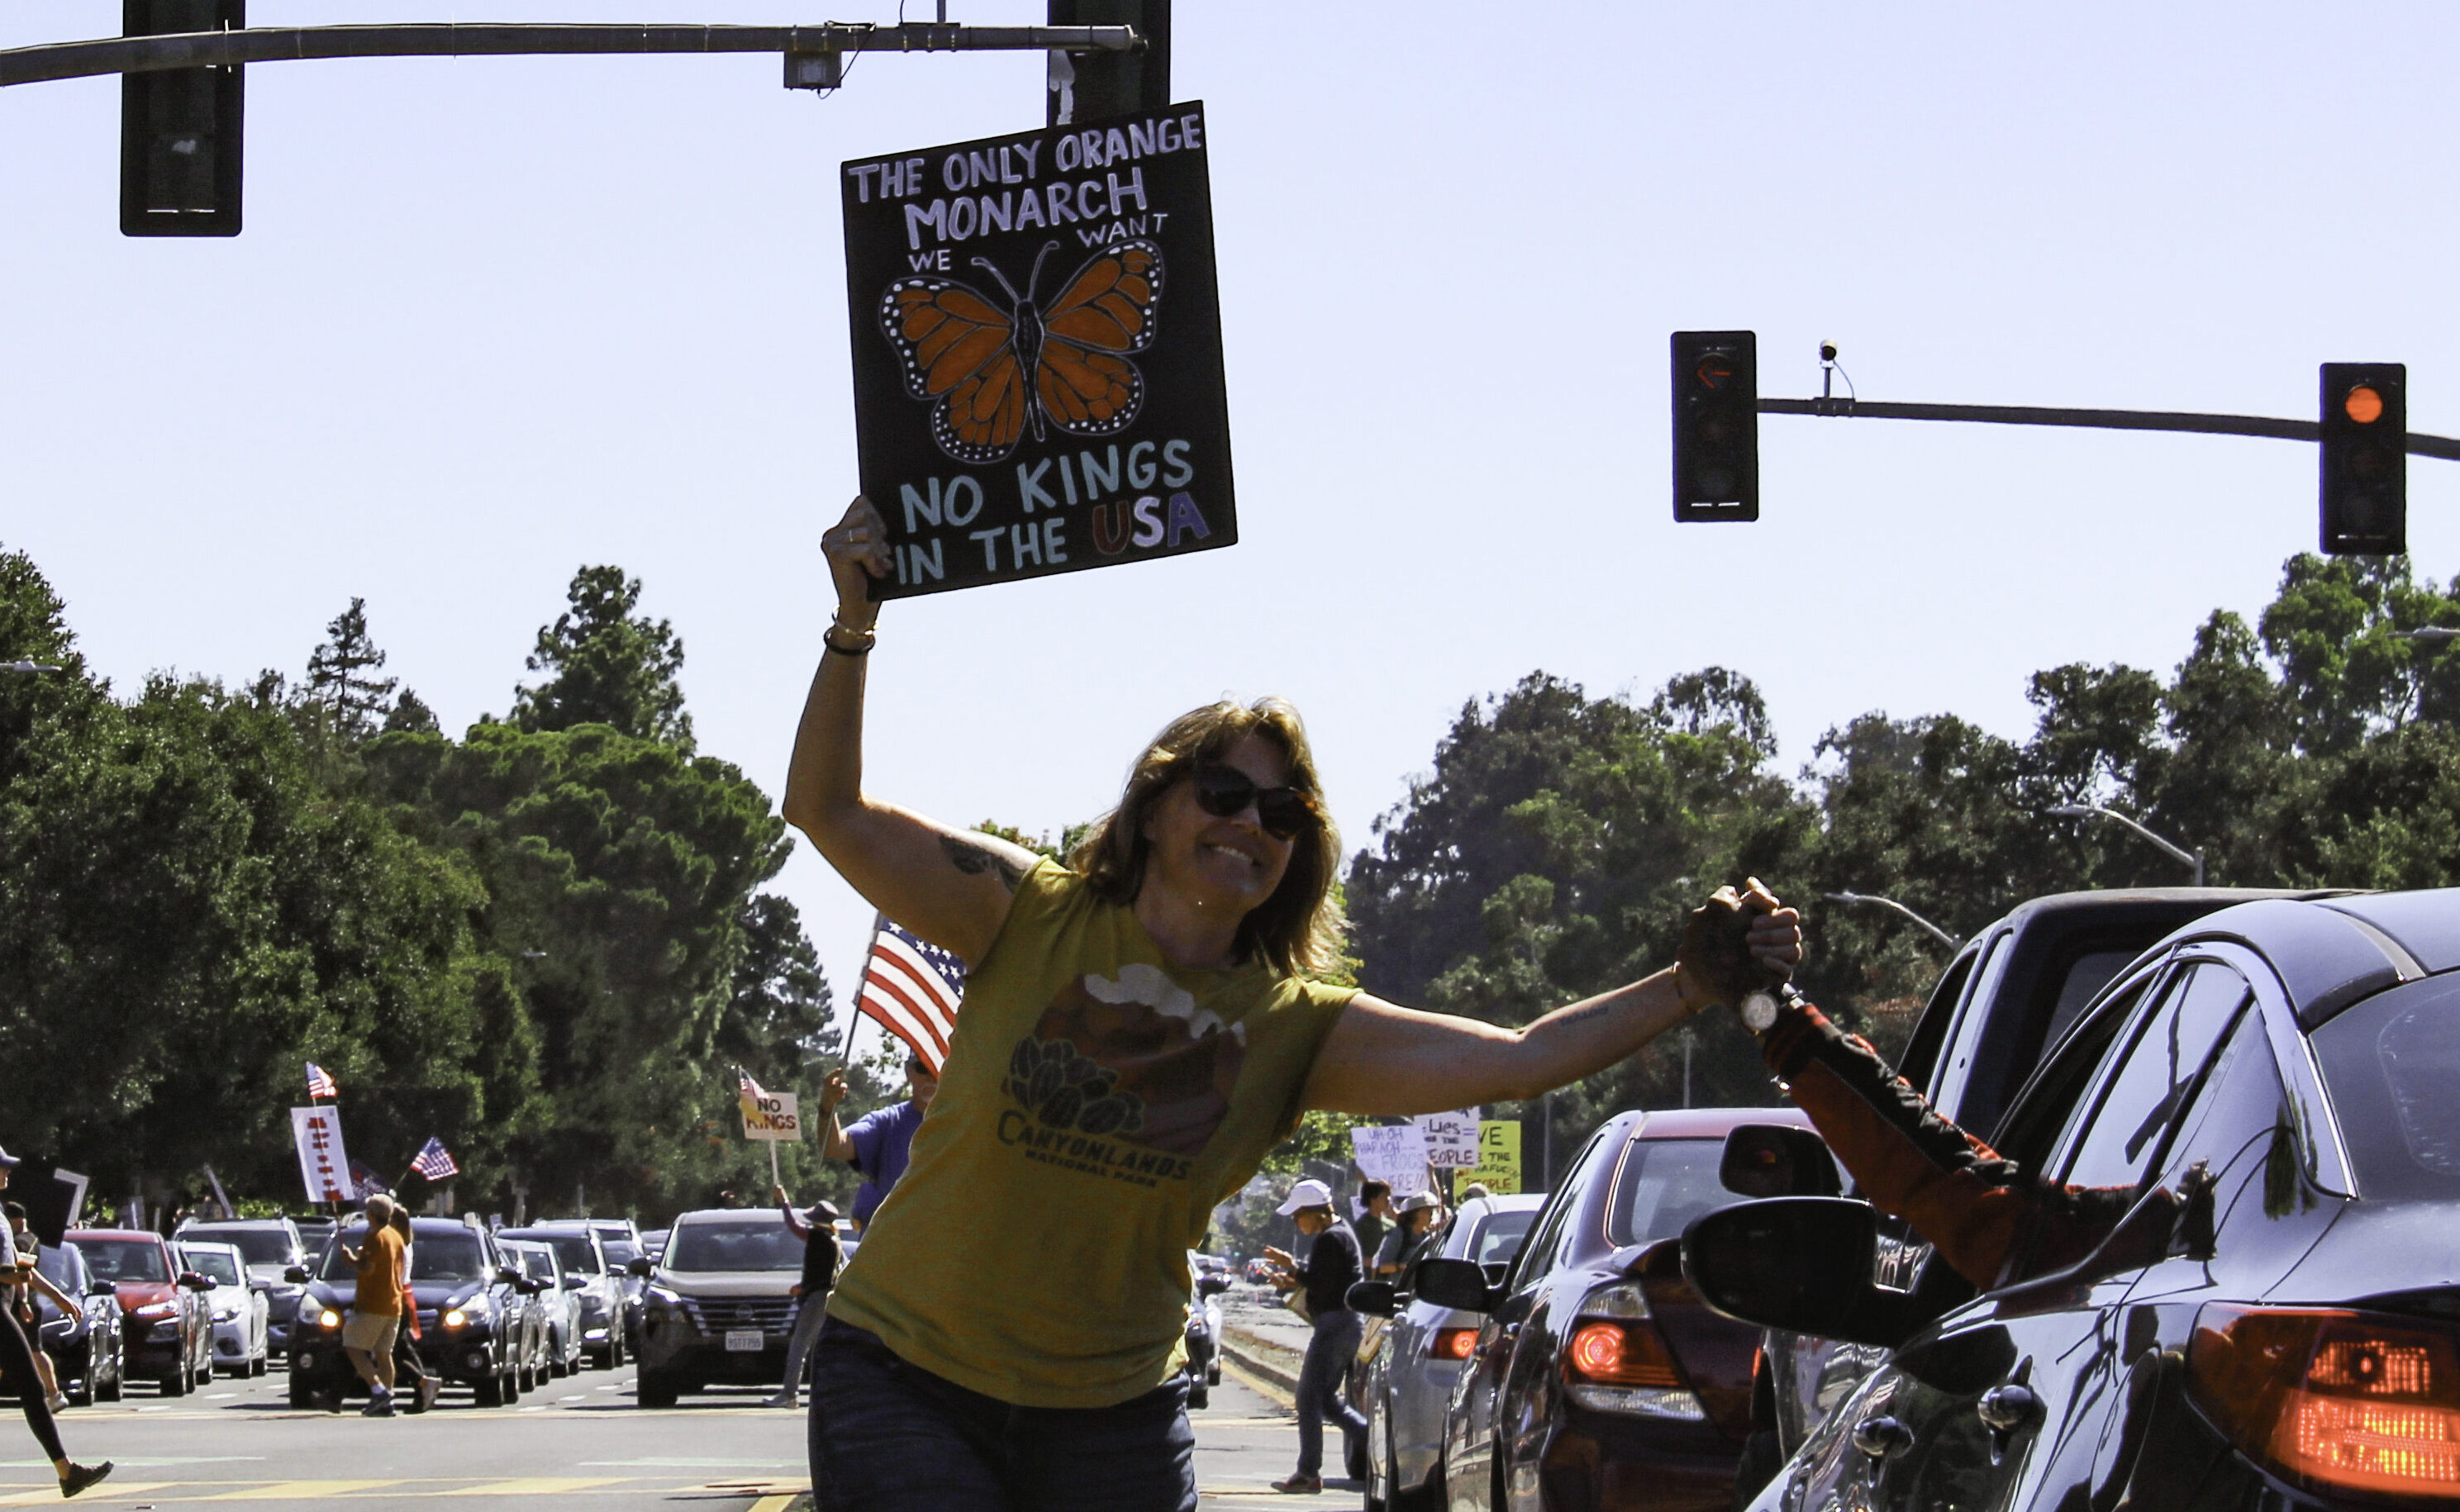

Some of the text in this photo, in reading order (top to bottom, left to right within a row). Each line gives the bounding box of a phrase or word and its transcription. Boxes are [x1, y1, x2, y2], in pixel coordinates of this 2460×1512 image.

[849, 113, 1201, 202] THE ONLY ORANGE
[904, 167, 1148, 249] MONARCH
[909, 213, 1168, 273] WE WANT
[900, 440, 1193, 534] NO KINGS
[895, 491, 1211, 585] IN THE USA
[757, 1098, 782, 1113] NO
[997, 1110, 1192, 1180] CANYONLANDS
[1427, 1148, 1474, 1165] EOPLE
